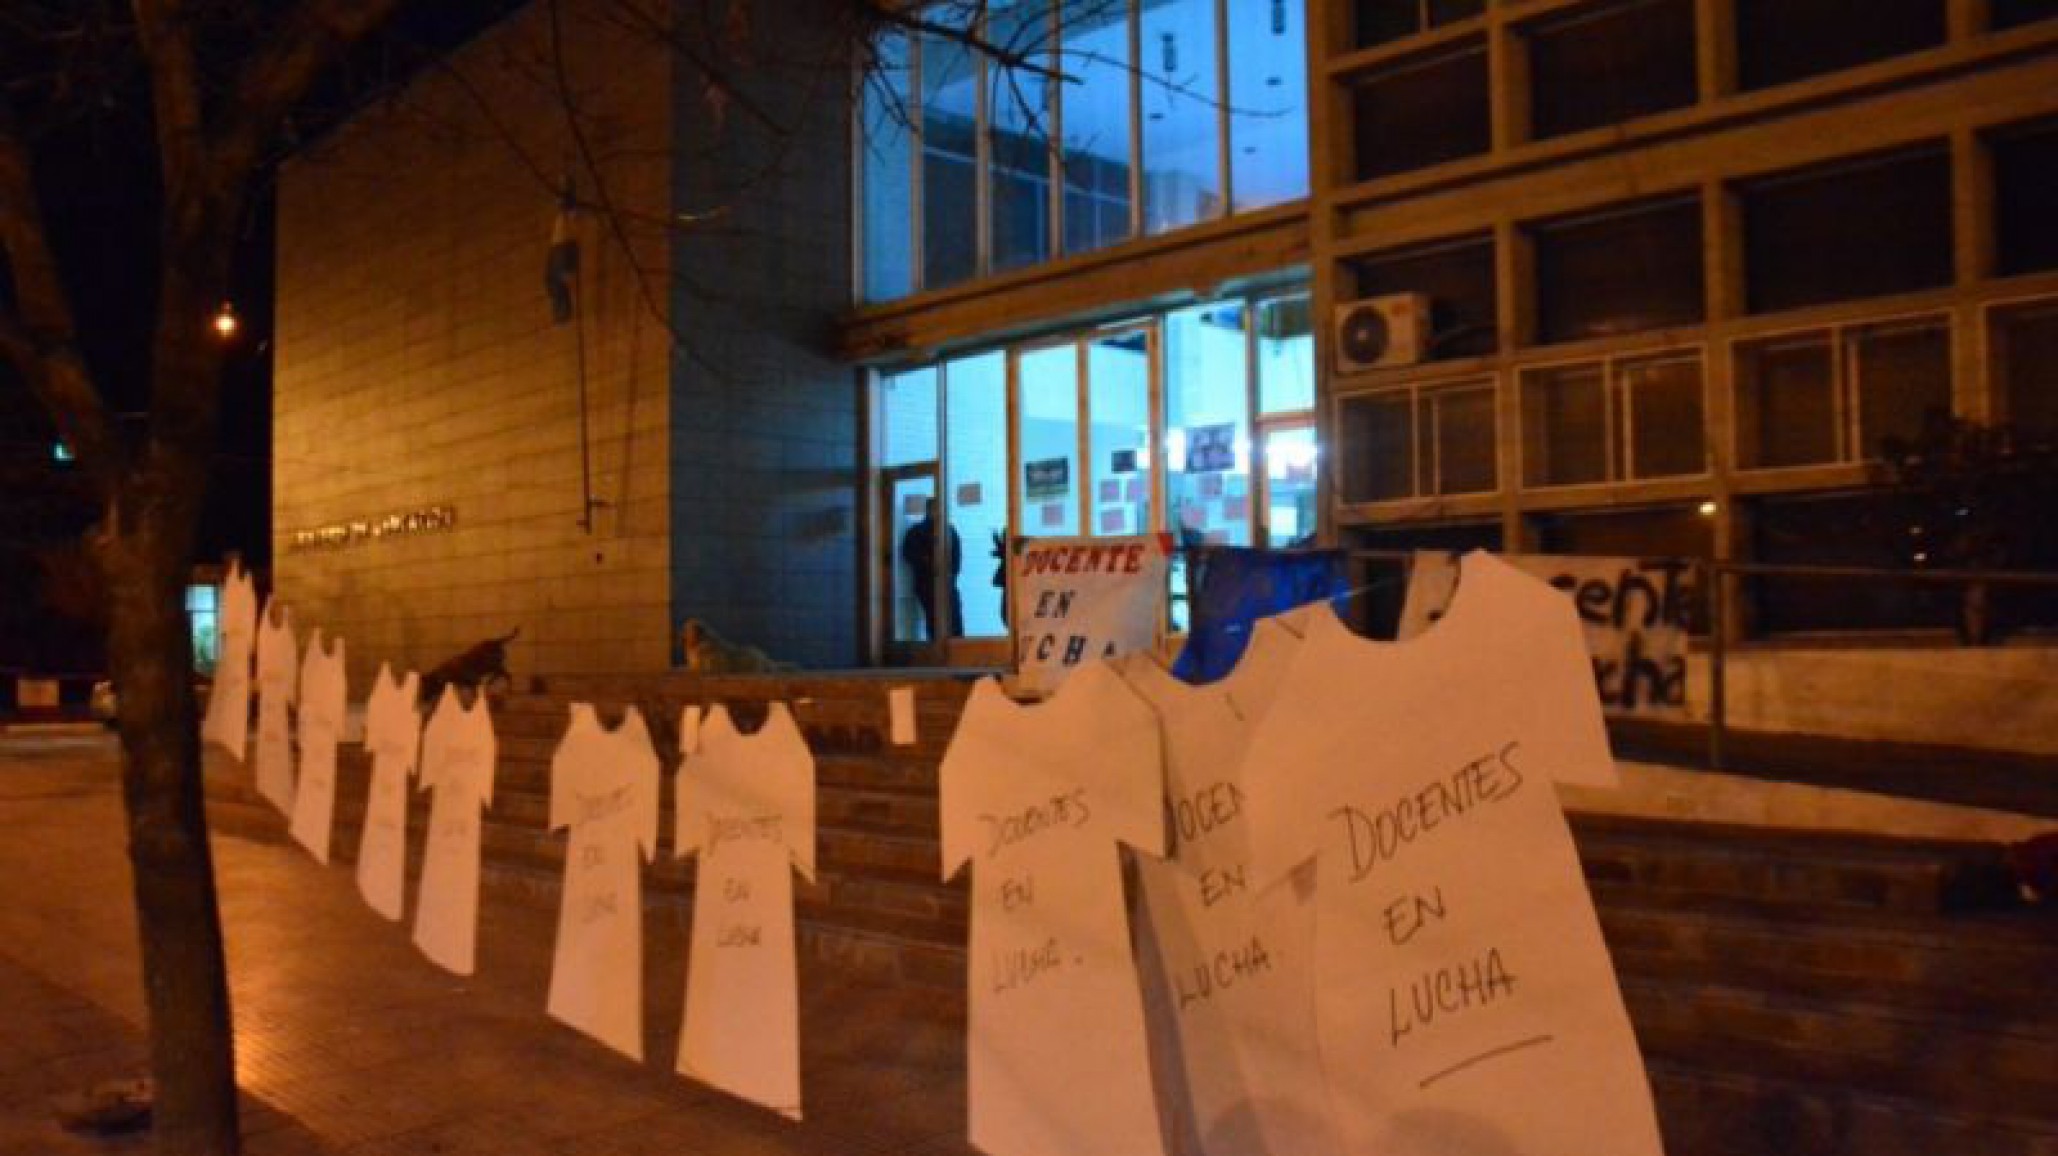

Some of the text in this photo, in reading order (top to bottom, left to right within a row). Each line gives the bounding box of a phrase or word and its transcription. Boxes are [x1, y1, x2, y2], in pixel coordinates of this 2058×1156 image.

[1034, 589, 1078, 618] EN
[1327, 741, 1524, 883] DOCENTES
[1200, 864, 1247, 907] EN
[1384, 885, 1446, 945] EN
[1387, 946, 1519, 1048] LUCHA
